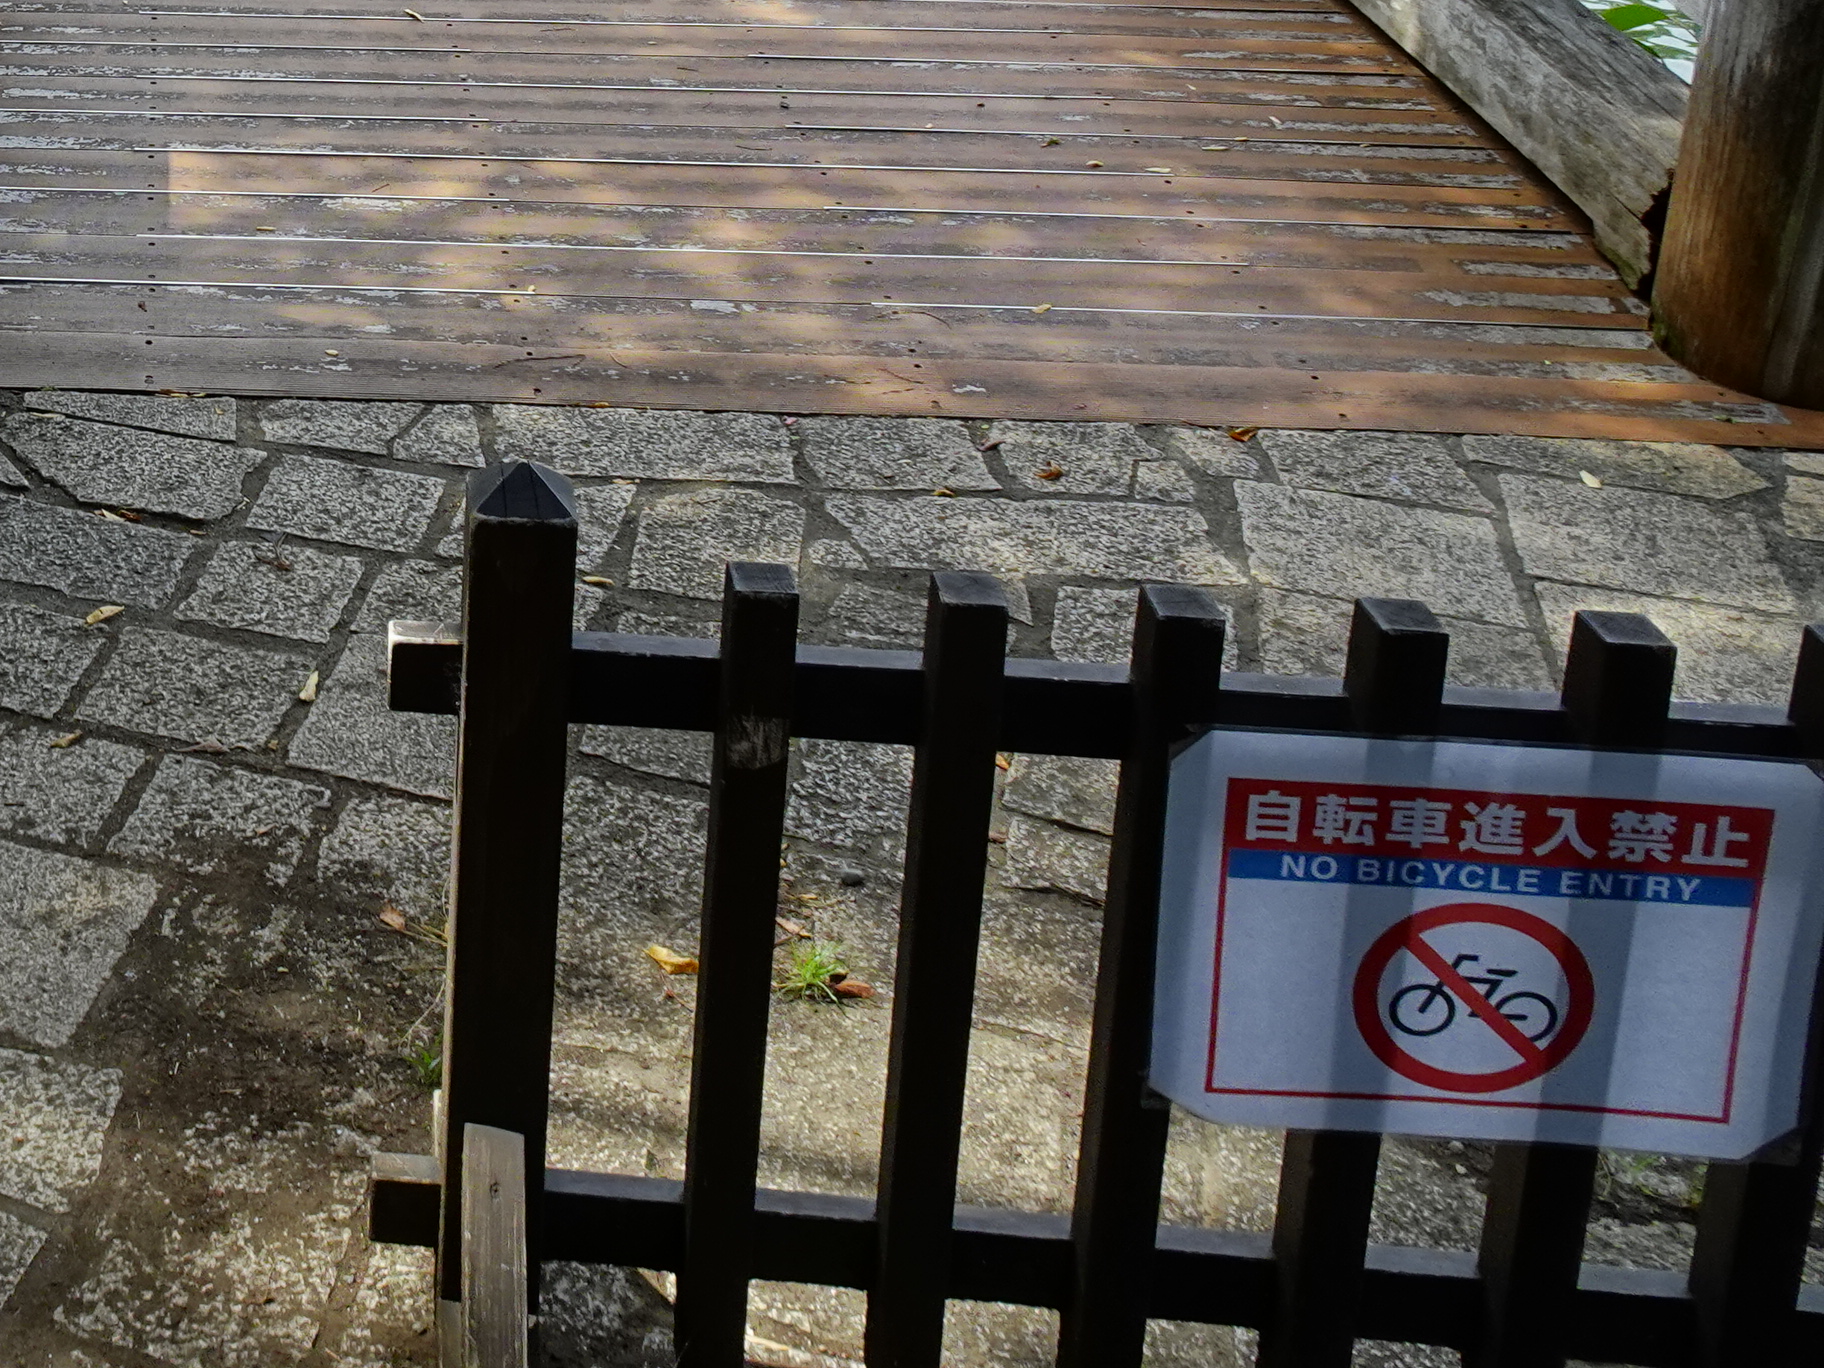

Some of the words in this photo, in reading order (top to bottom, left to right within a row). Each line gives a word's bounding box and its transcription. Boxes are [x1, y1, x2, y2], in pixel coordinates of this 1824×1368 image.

[1245, 790, 1750, 868] 自転車進入禁止
[1281, 854, 1338, 880] NO
[1357, 858, 1541, 894] BICYCLE
[1560, 870, 1701, 902] ENTRY
